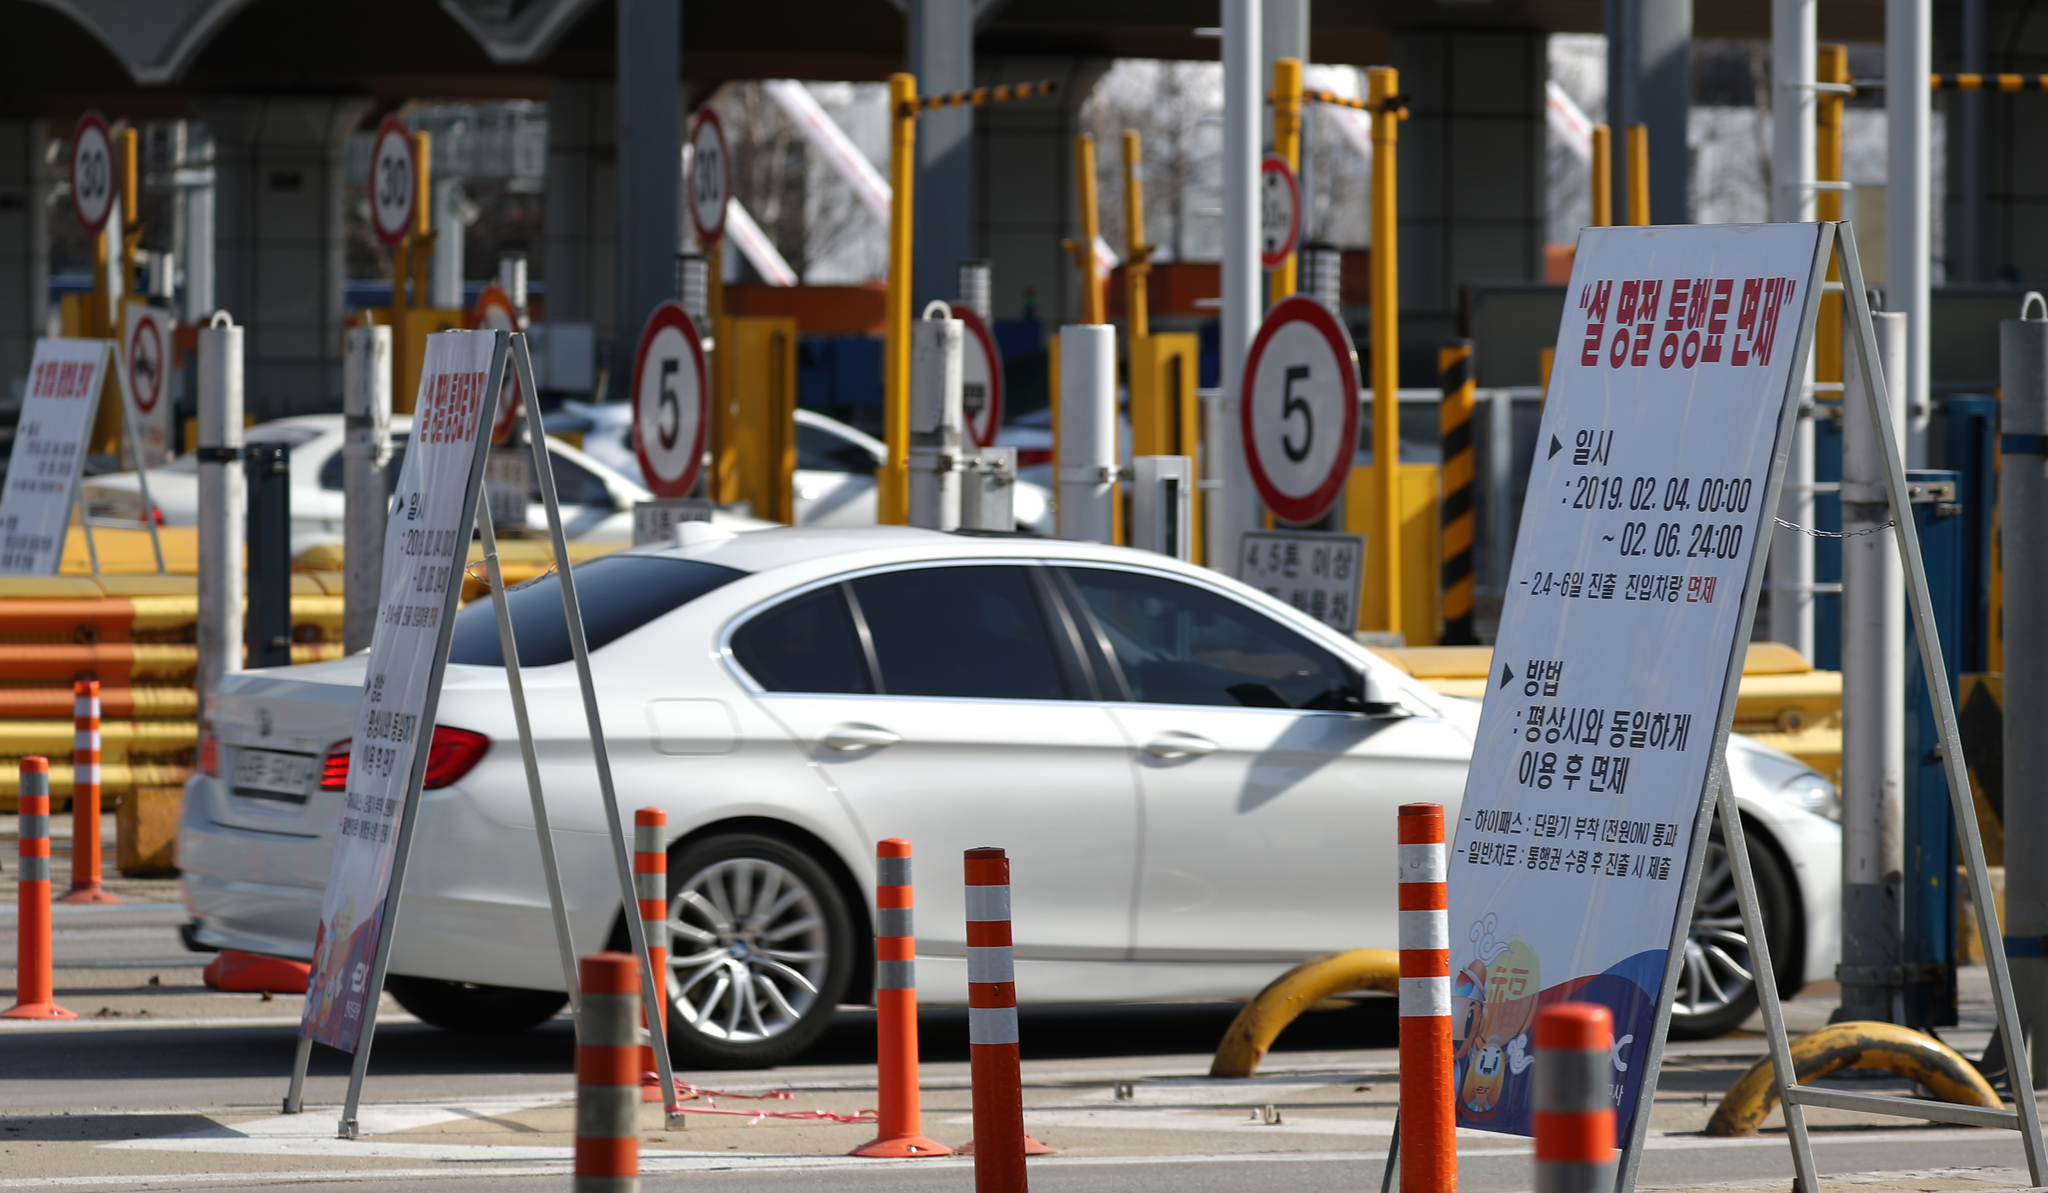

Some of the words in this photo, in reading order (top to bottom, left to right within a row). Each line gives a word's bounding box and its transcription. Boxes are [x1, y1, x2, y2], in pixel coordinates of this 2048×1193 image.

[81, 149, 106, 199] 30
[381, 155, 406, 208] 30
[1610, 279, 1663, 369] 명절
[1659, 278, 1735, 369] 통행료
[658, 357, 681, 451] 5
[1281, 364, 1315, 464] 5
[1572, 428, 1614, 467] 일시
[1572, 475, 1623, 511] 2019.
[1629, 476, 1657, 511] 02.
[1663, 477, 1691, 511] 04.
[1697, 478, 1752, 513] 00:00
[1620, 521, 1647, 556] 02.
[1653, 522, 1681, 557] 06.
[1686, 523, 1743, 559] 24:00
[1312, 543, 1353, 580] 이상
[1531, 571, 1584, 598] 2.4~6일
[1588, 572, 1617, 600] 진출
[1625, 574, 1683, 603] 진입차량
[1686, 576, 1717, 604] 면제
[1523, 659, 1563, 697] 방법
[1525, 705, 1604, 746] 평상시와
[1609, 710, 1692, 752] 동일하게
[1518, 750, 1558, 790] 이용
[1563, 753, 1583, 791] 후
[1589, 755, 1630, 794] 면제
[1475, 808, 1524, 835] 하이패스
[1534, 813, 1571, 840] 단말기
[1574, 816, 1600, 841] 부착
[1652, 822, 1678, 847] 통과
[1468, 840, 1517, 867] 일반차로
[1527, 846, 1562, 871] 통행권
[1565, 849, 1589, 874] 수령
[1591, 851, 1603, 875] 후
[1605, 852, 1631, 877] 진출
[1631, 855, 1646, 879] 시
[1646, 856, 1672, 880] 제출
